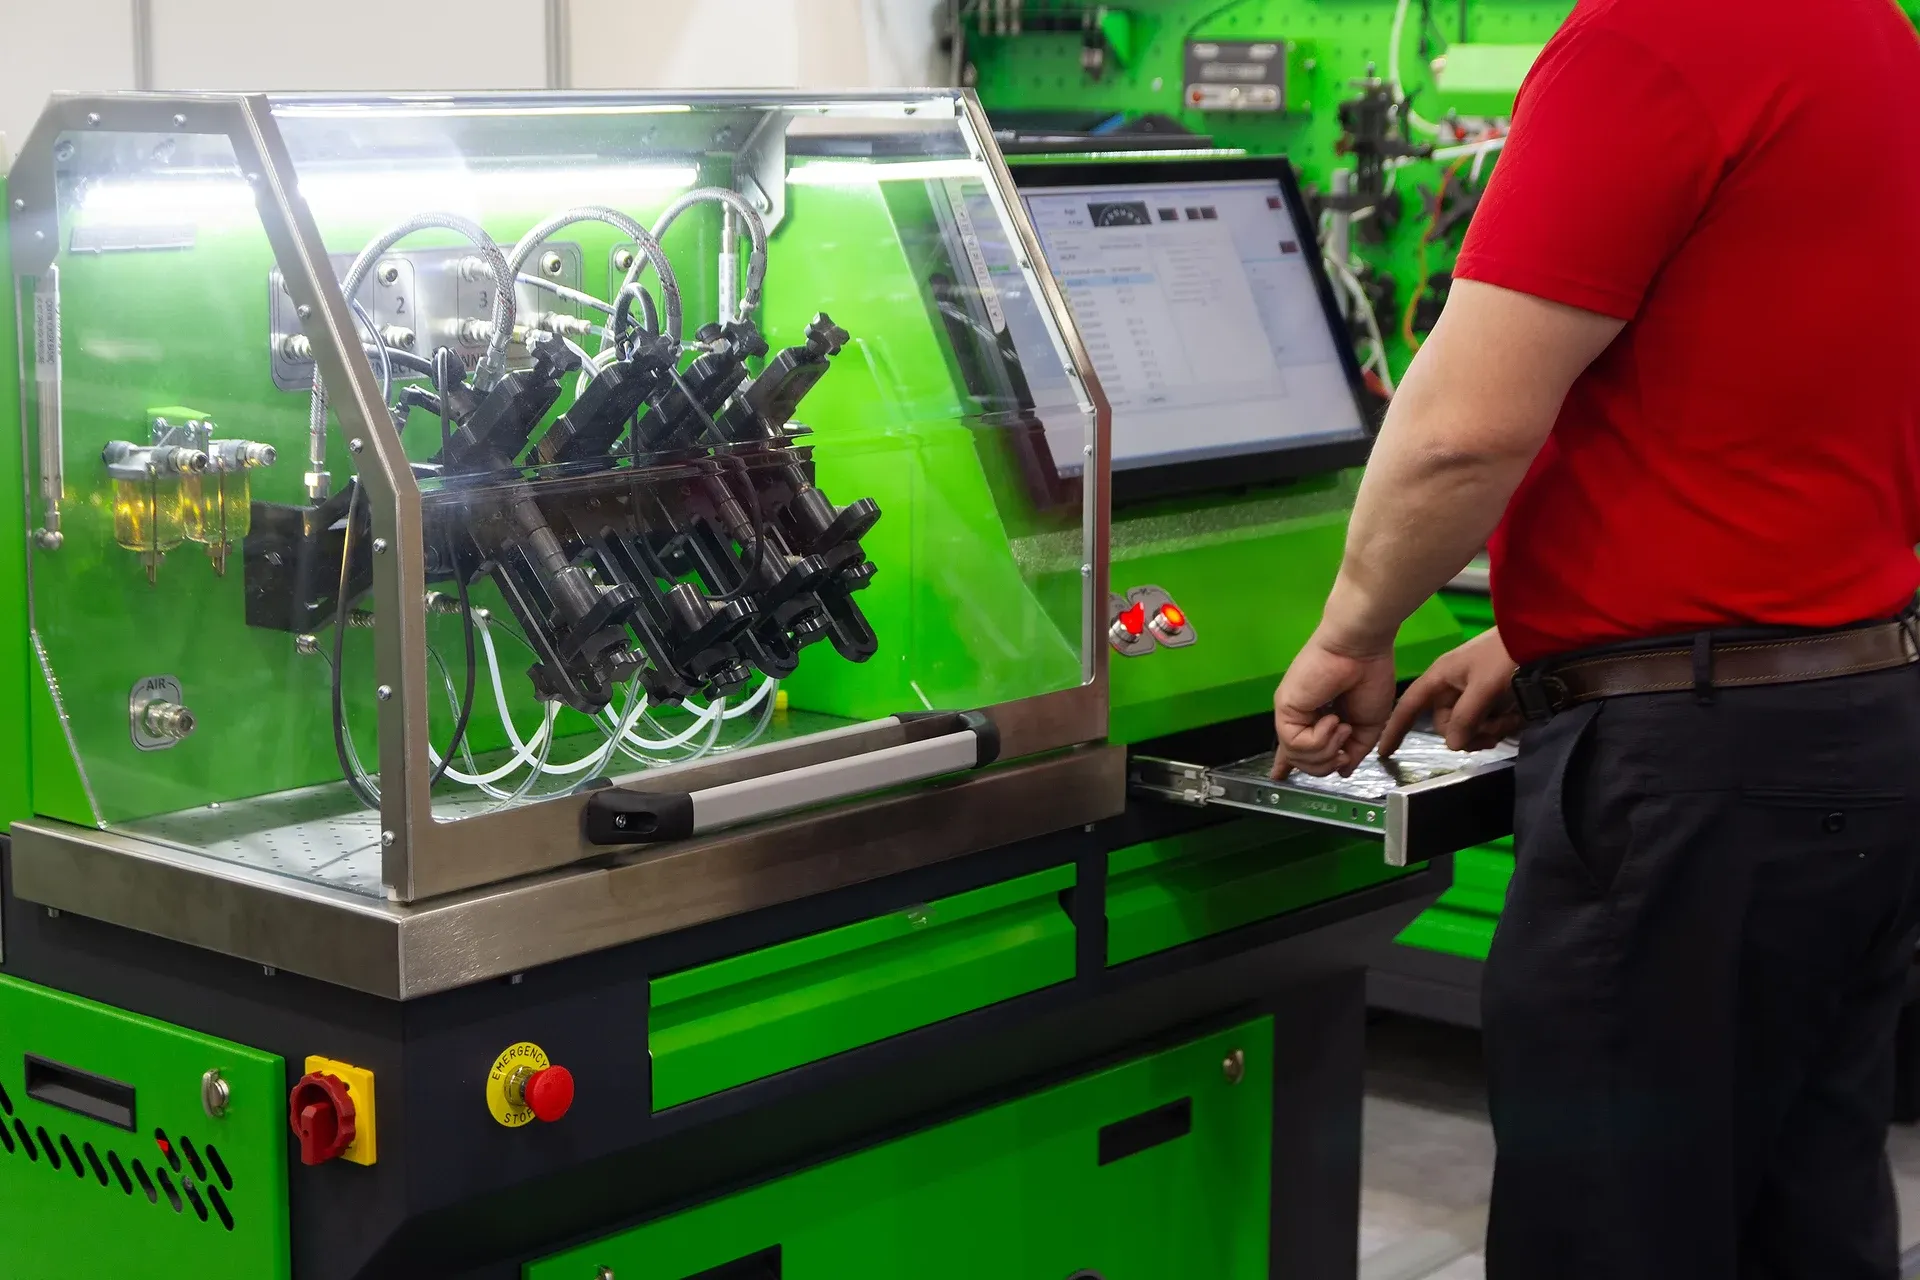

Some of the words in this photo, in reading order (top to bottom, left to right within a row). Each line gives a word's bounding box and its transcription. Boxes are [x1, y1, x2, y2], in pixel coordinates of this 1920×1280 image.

[395, 296, 407, 315] 2
[478, 290, 489, 309] 3
[146, 678, 166, 691] AIR
[491, 1045, 549, 1081] EMERGENCY
